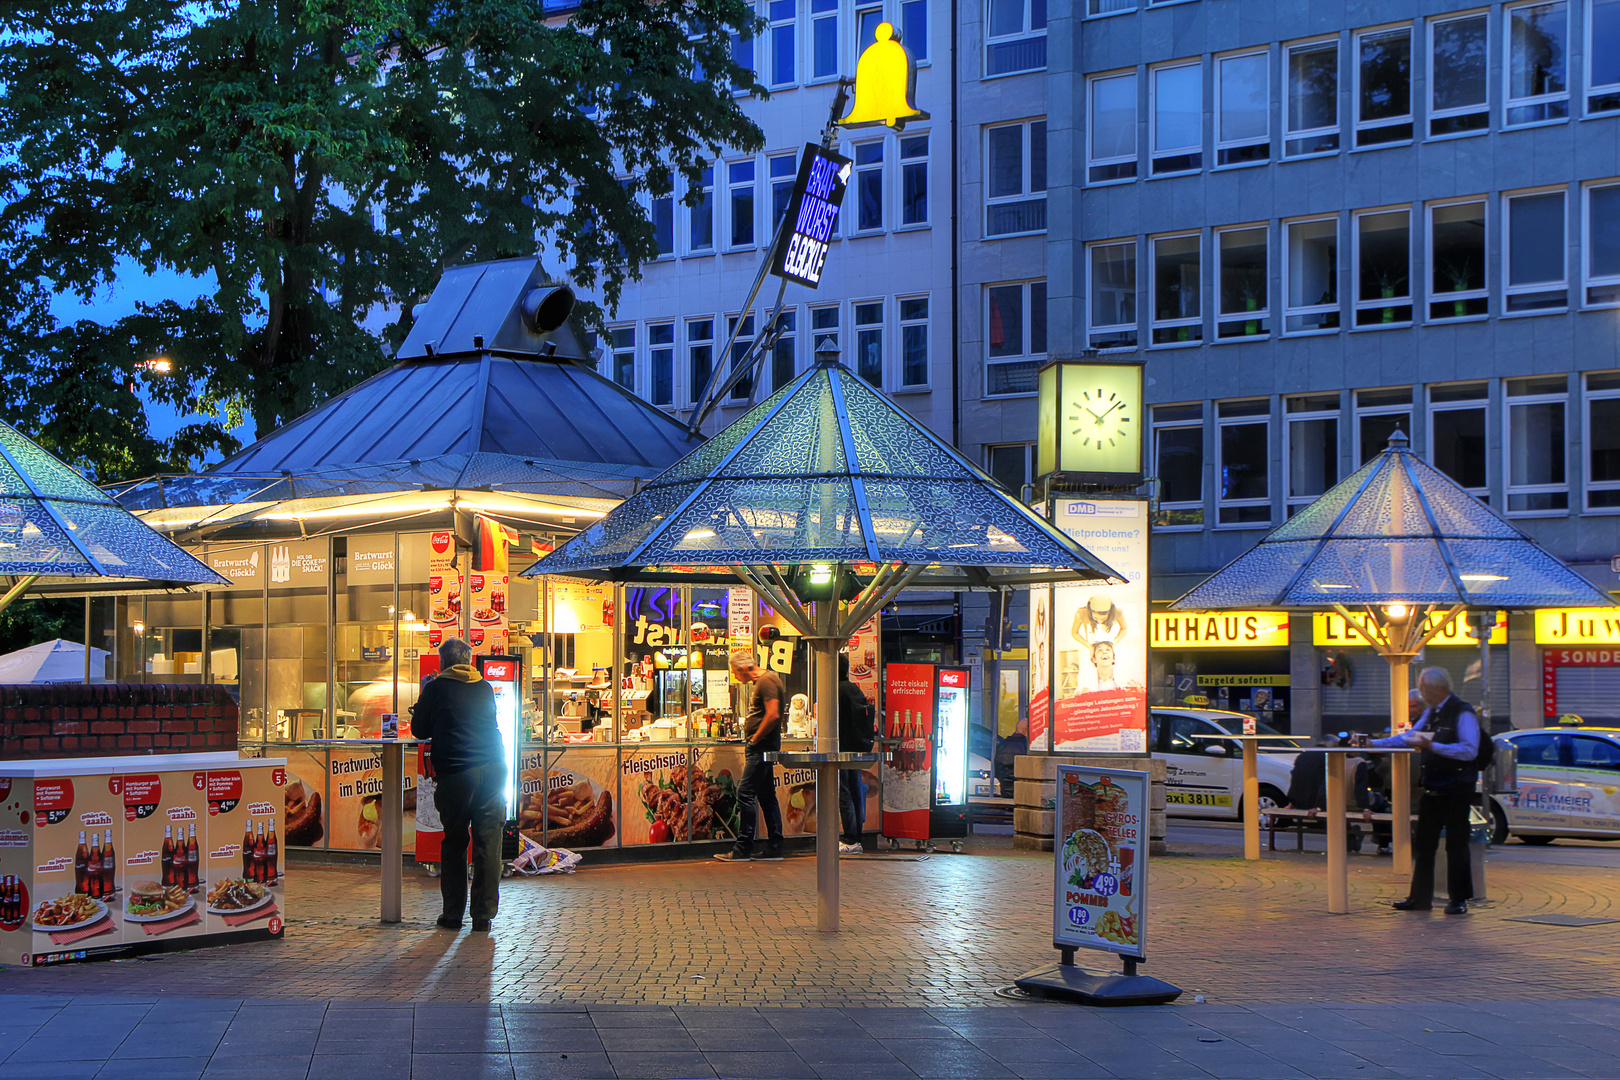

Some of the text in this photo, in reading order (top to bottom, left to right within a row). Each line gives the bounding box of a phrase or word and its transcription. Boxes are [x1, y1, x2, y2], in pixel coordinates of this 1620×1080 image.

[795, 193, 839, 243] WURST
[1069, 504, 1095, 514] DMB
[1063, 528, 1140, 539] Mietprobleme?
[302, 559, 318, 567] COKE
[229, 567, 256, 577] Glöckle
[1129, 571, 1141, 580] 60
[487, 666, 506, 676] Coca-Cola
[942, 674, 958, 683] Coca-Cola
[1198, 676, 1234, 686] Bargeld
[1238, 676, 1268, 684] sofort
[908, 680, 929, 688] eiskalt
[893, 688, 926, 696] erfrischen!
[1179, 768, 1206, 777] Zentrum
[196, 779, 203, 788] 4
[276, 775, 281, 784] 5
[521, 773, 574, 794] ommes
[113, 784, 118, 793] 1
[339, 782, 353, 798] im
[1166, 794, 1184, 804] axi
[1188, 794, 1215, 805] 3811
[1526, 793, 1591, 808] HEYMEIER
[171, 811, 196, 820] aaahh
[252, 806, 275, 815] aaahh
[85, 816, 112, 826] aaahh
[1105, 812, 1140, 825] GYROS-
[1107, 826, 1137, 839] TELLER
[1066, 891, 1109, 908] POMMES
